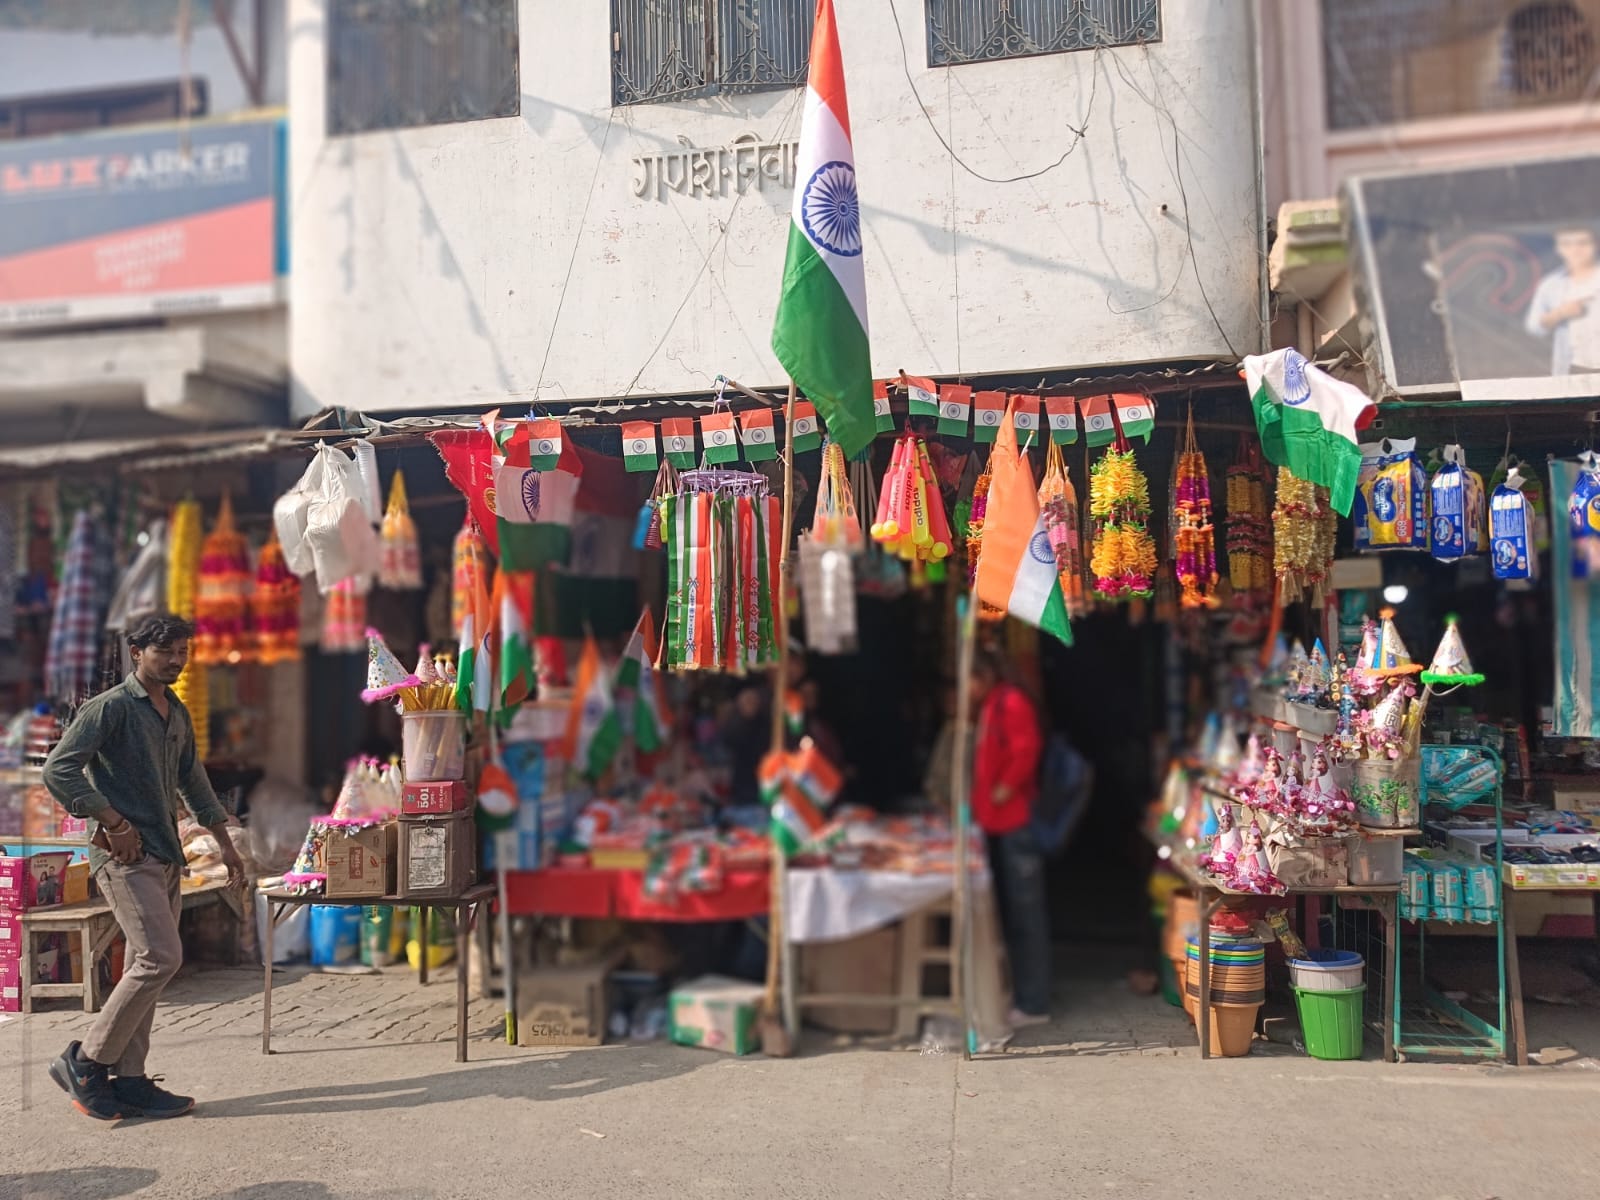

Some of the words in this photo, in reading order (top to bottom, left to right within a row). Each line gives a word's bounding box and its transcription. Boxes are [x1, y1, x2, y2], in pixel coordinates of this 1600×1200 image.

[3, 155, 99, 191] LUX
[107, 142, 250, 181] PARKER
[729, 130, 800, 196] निवा
[904, 472, 912, 511] adidas
[420, 788, 430, 809] 501
